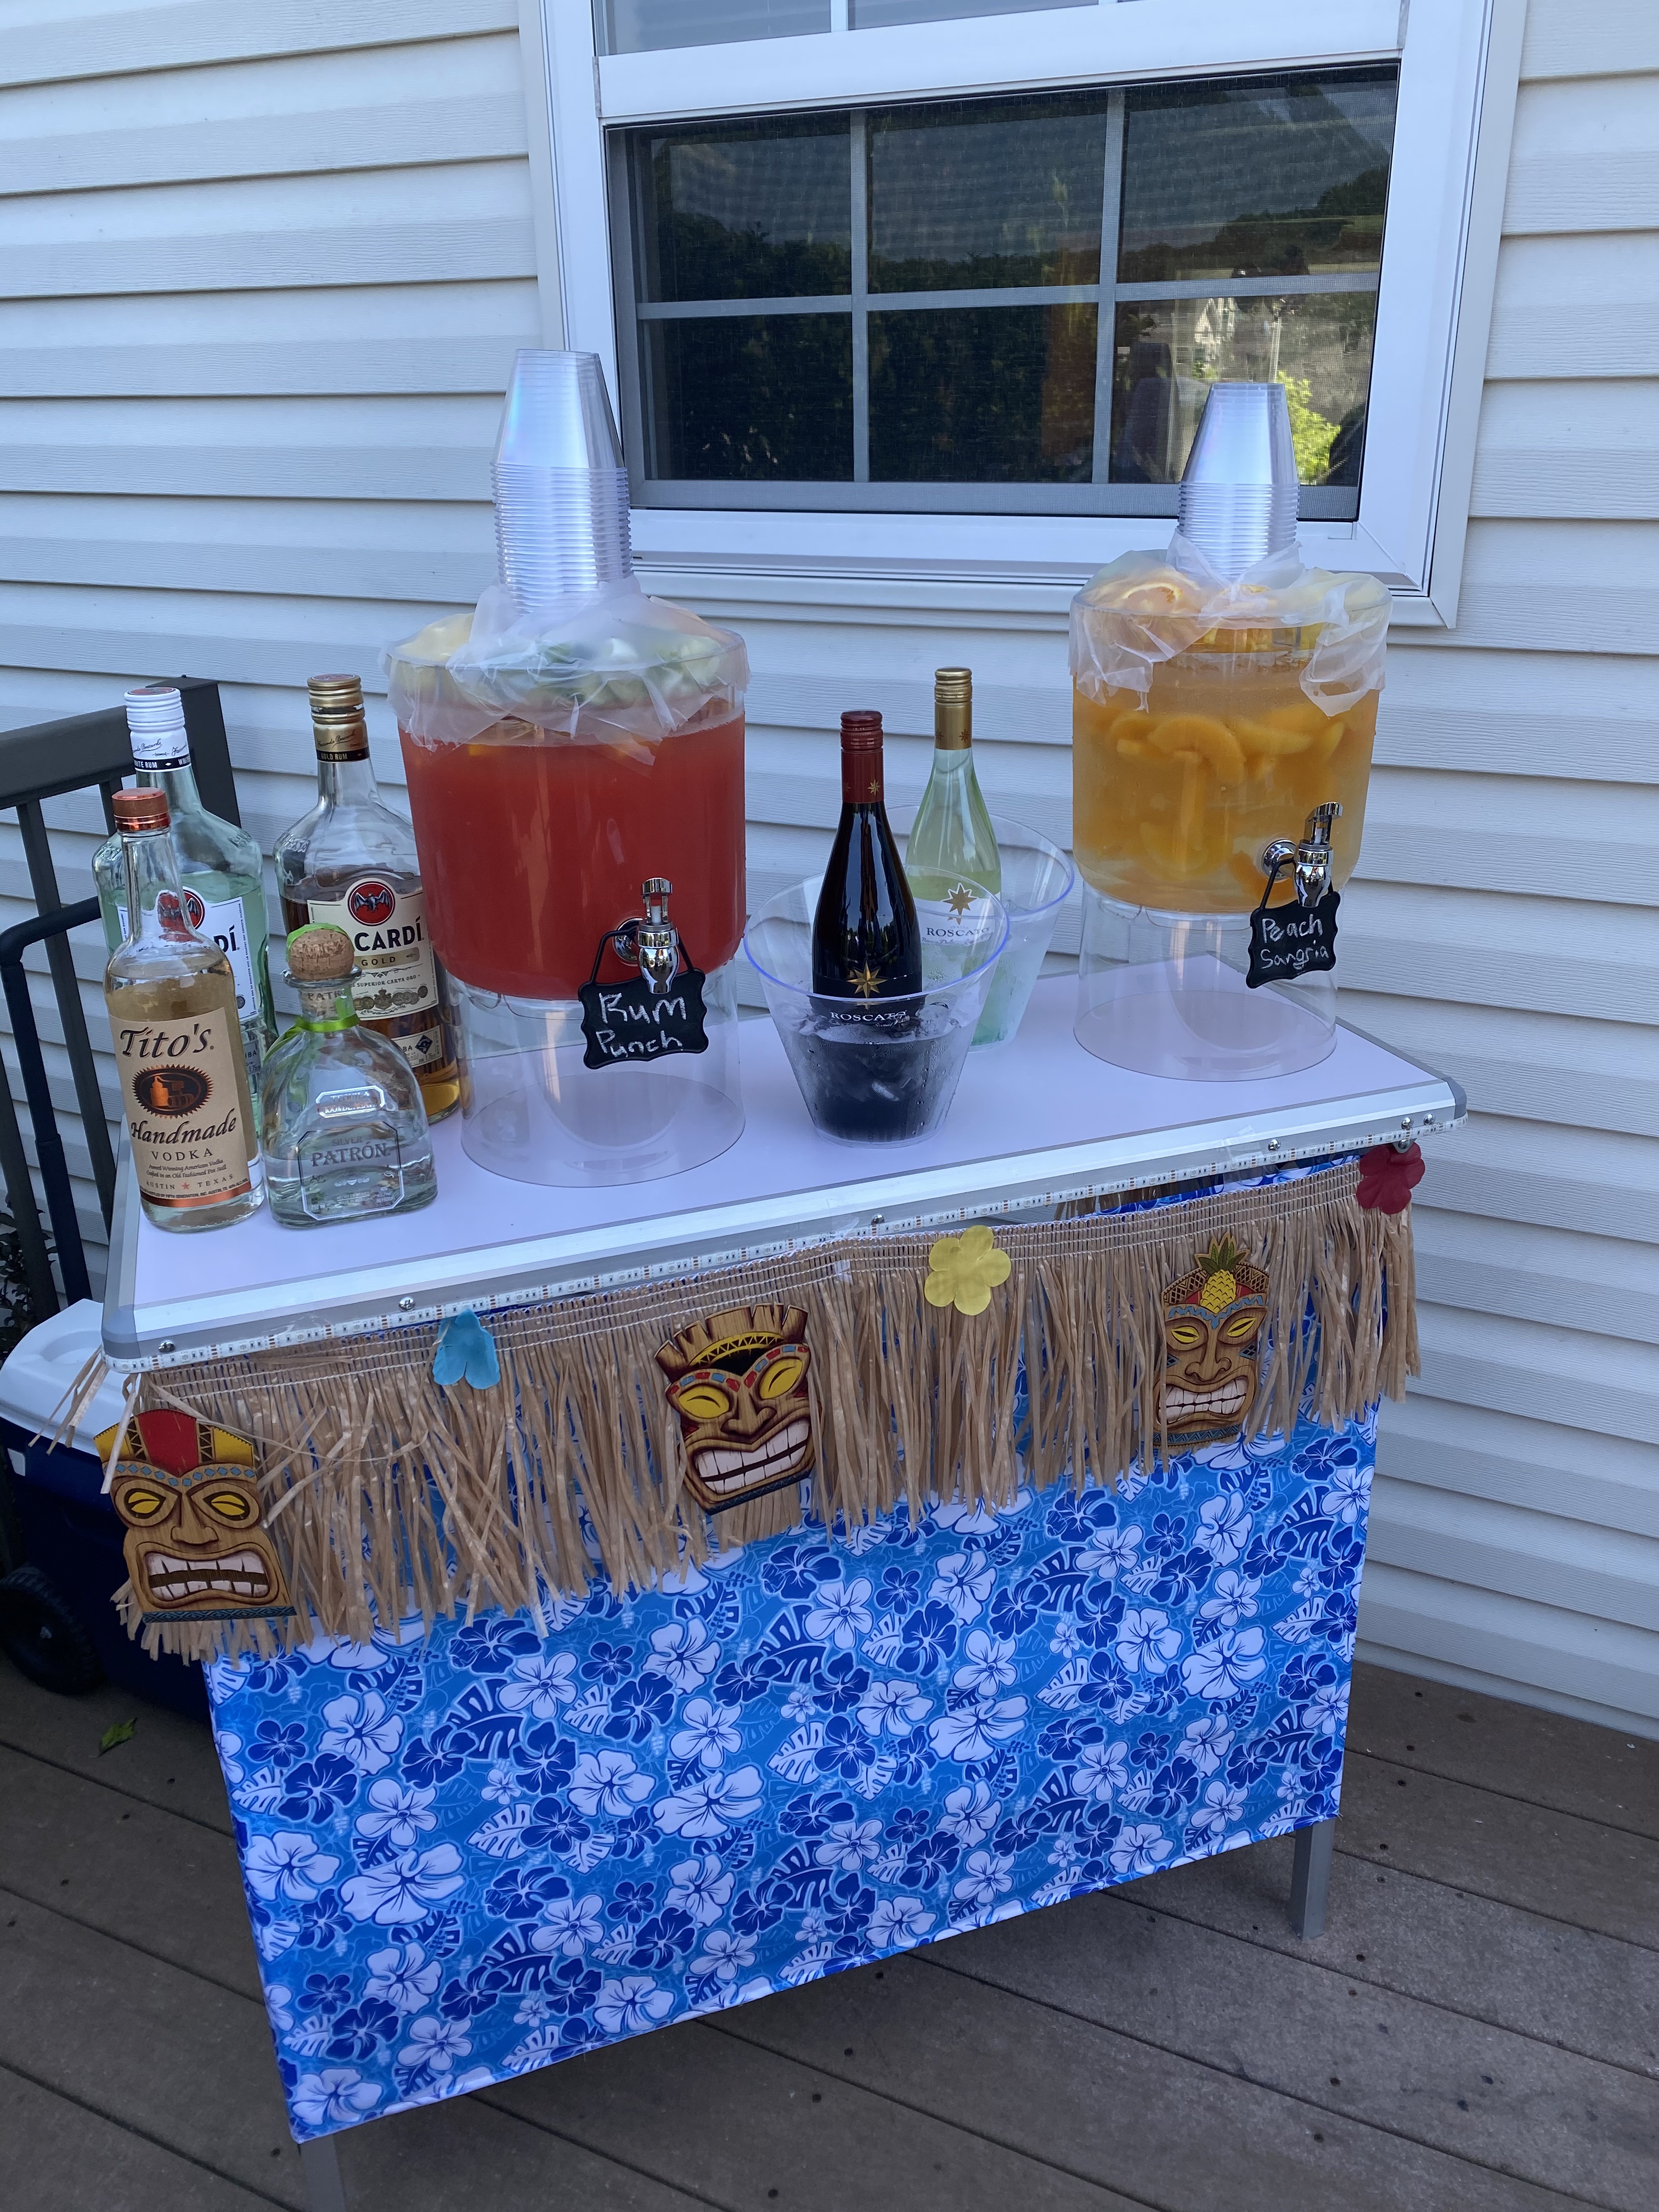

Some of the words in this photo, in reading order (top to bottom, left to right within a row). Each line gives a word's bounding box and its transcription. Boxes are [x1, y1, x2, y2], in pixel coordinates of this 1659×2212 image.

[354, 916, 422, 951] CARDÍ
[926, 927, 989, 937] ROSCATO
[1262, 913, 1323, 943] Peach
[362, 956, 396, 966] GOLD
[1260, 940, 1329, 970] Sangria
[307, 990, 343, 1000] PATR
[830, 1012, 905, 1022] ROSCATO
[120, 1023, 212, 1058] Tito's
[596, 1029, 683, 1058] Punch
[131, 1108, 236, 1144] Handmade
[332, 1136, 363, 1147] SILVER
[151, 1148, 213, 1161] VODKA
[311, 1141, 391, 1167] PATRÓN
[182, 1169, 206, 1178] Fashioned
[146, 1181, 175, 1189] AUSTIN
[198, 1174, 233, 1187] TEXAS
